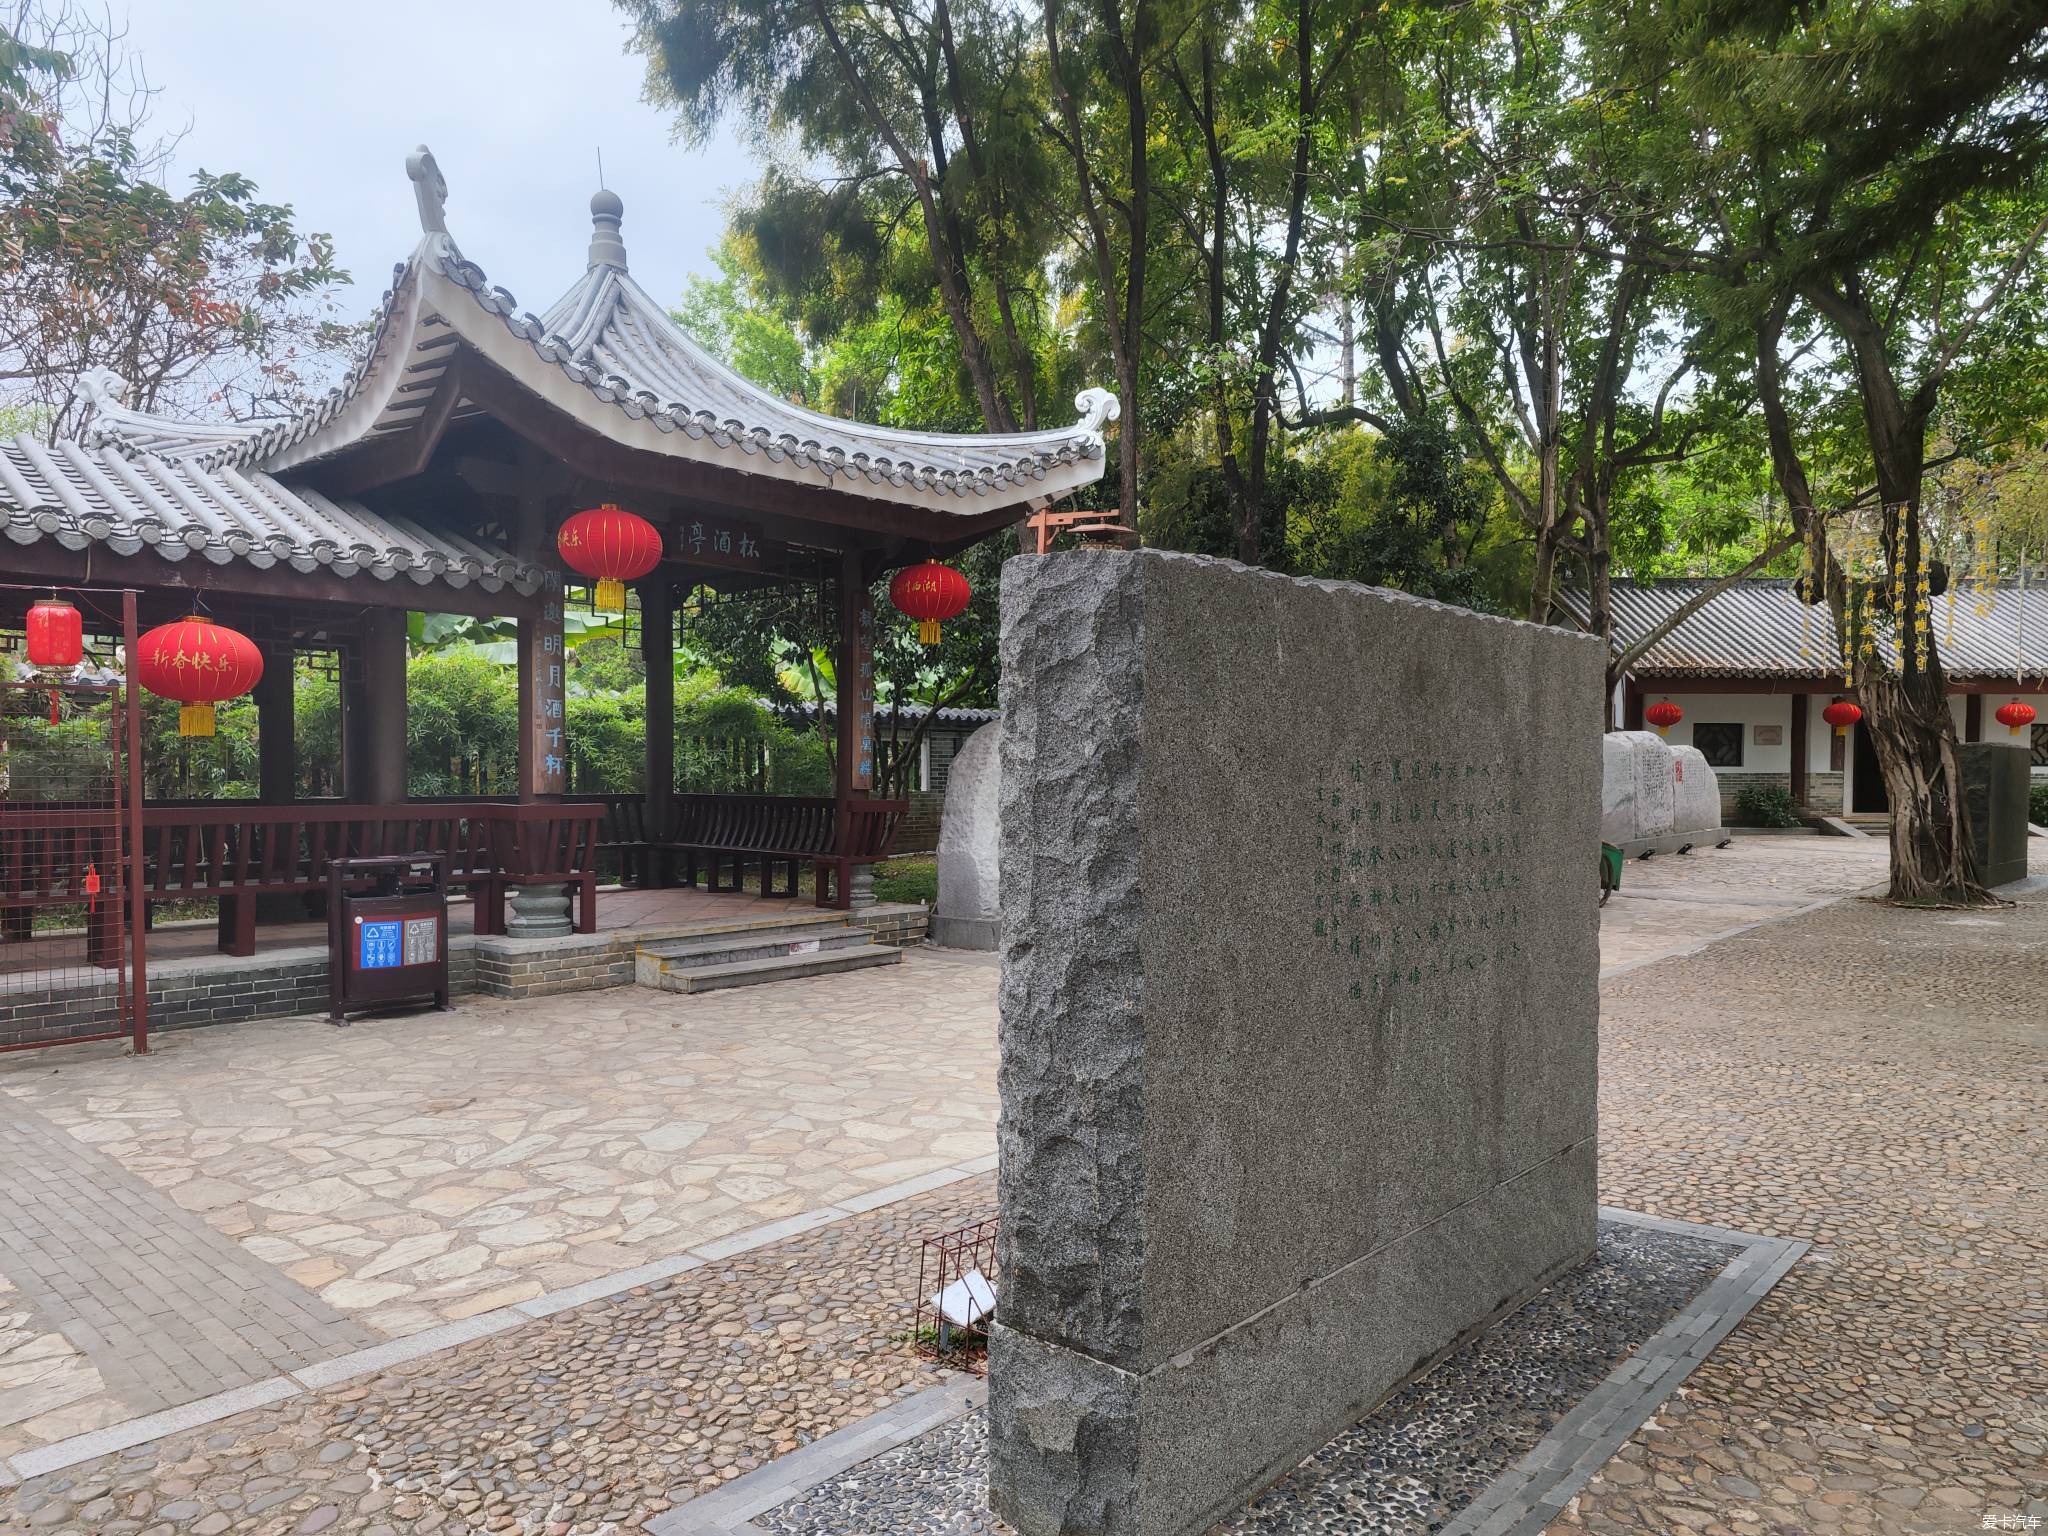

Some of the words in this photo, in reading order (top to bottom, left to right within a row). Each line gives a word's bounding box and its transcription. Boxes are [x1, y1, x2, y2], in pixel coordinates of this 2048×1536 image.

[895, 580, 937, 593] 州西湖
[151, 647, 233, 672] 新春快乐
